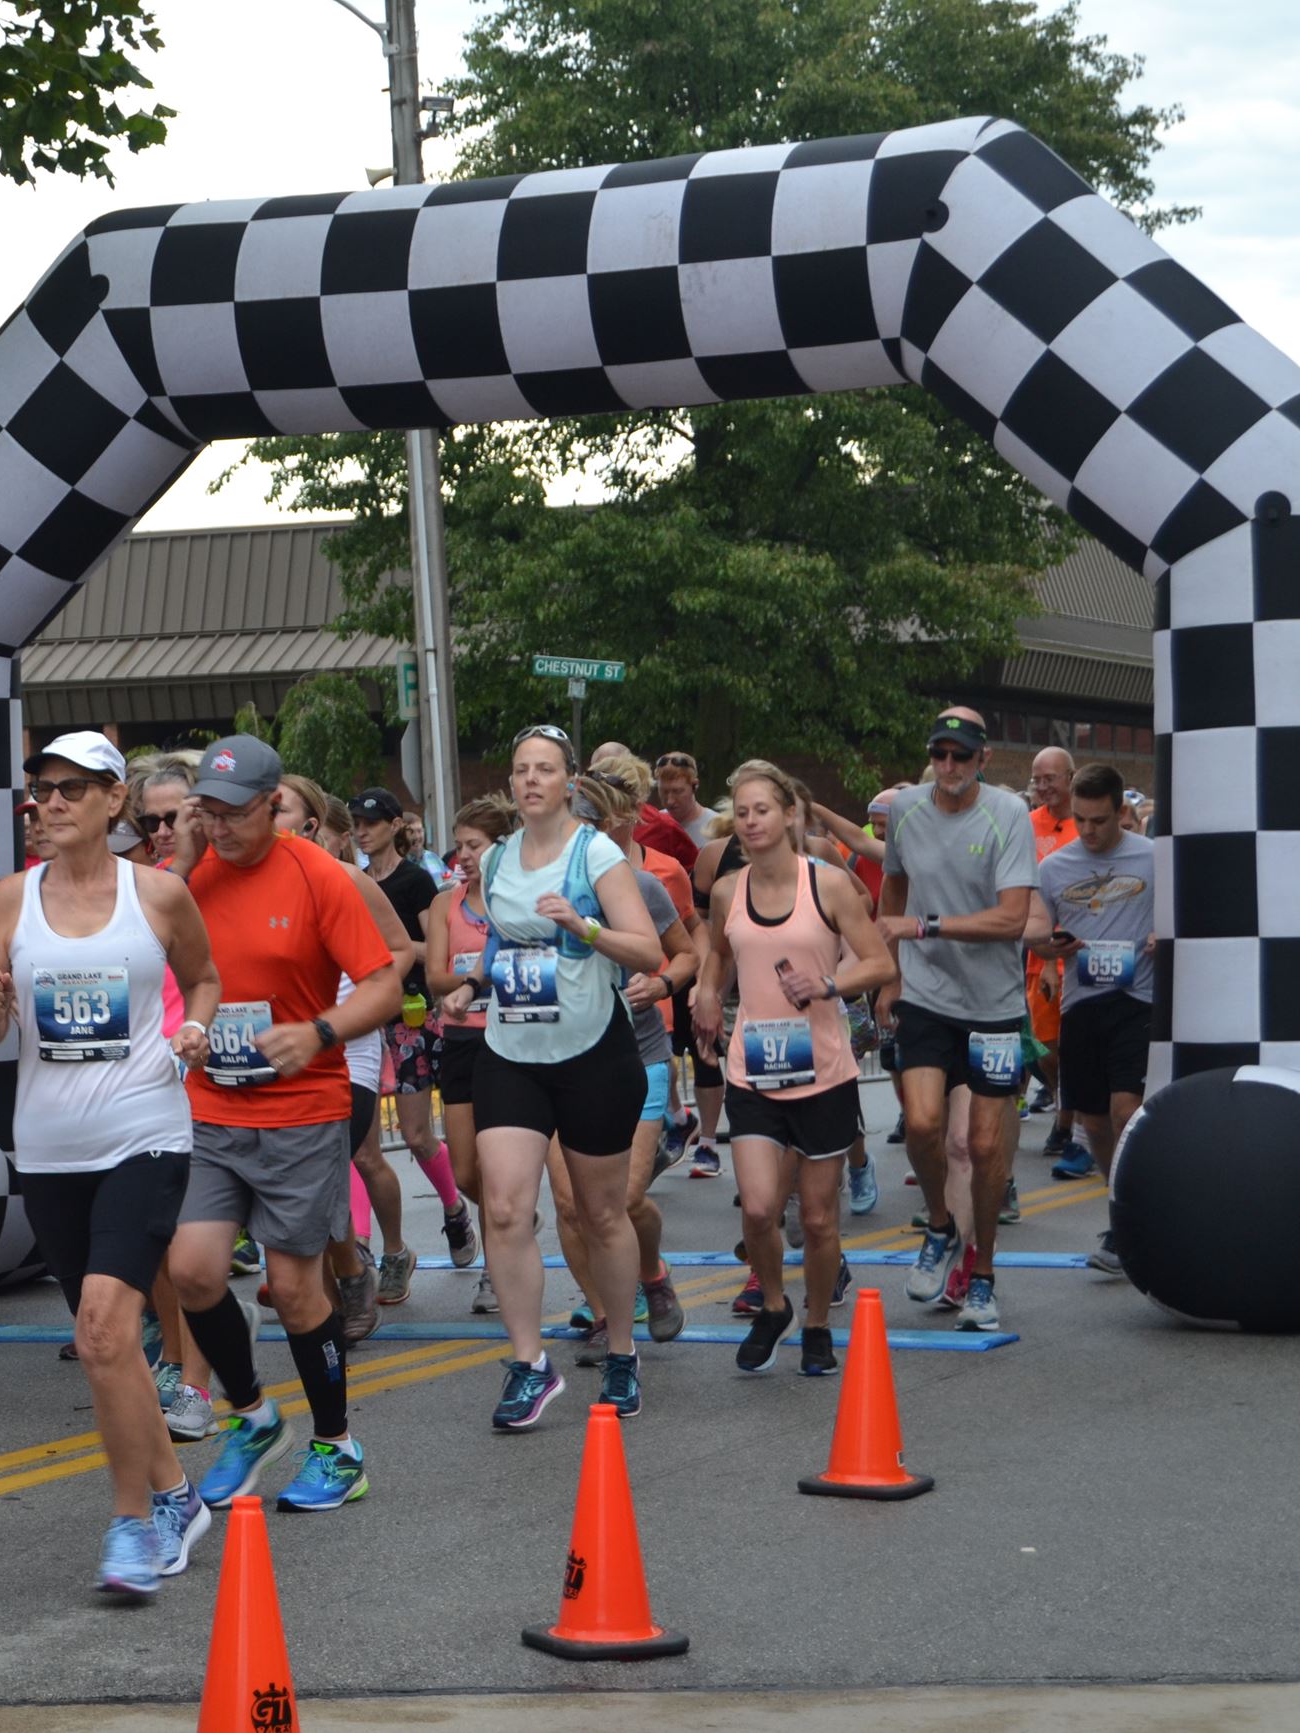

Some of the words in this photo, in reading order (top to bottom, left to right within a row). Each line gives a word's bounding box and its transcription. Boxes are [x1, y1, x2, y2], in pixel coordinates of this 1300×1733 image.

[535, 659, 600, 676] CHESTNUT
[604, 665, 621, 679] ST
[57, 972, 82, 980] GRAND
[1088, 954, 1123, 976] 655
[53, 989, 111, 1025] 563
[70, 1026, 94, 1035] JANE
[208, 1022, 257, 1054] 664
[220, 1055, 248, 1064] RALPH
[763, 1034, 789, 1063] 97
[764, 1061, 792, 1071] RACHEL
[982, 1048, 1015, 1073] 574
[252, 1695, 289, 1725] GT
